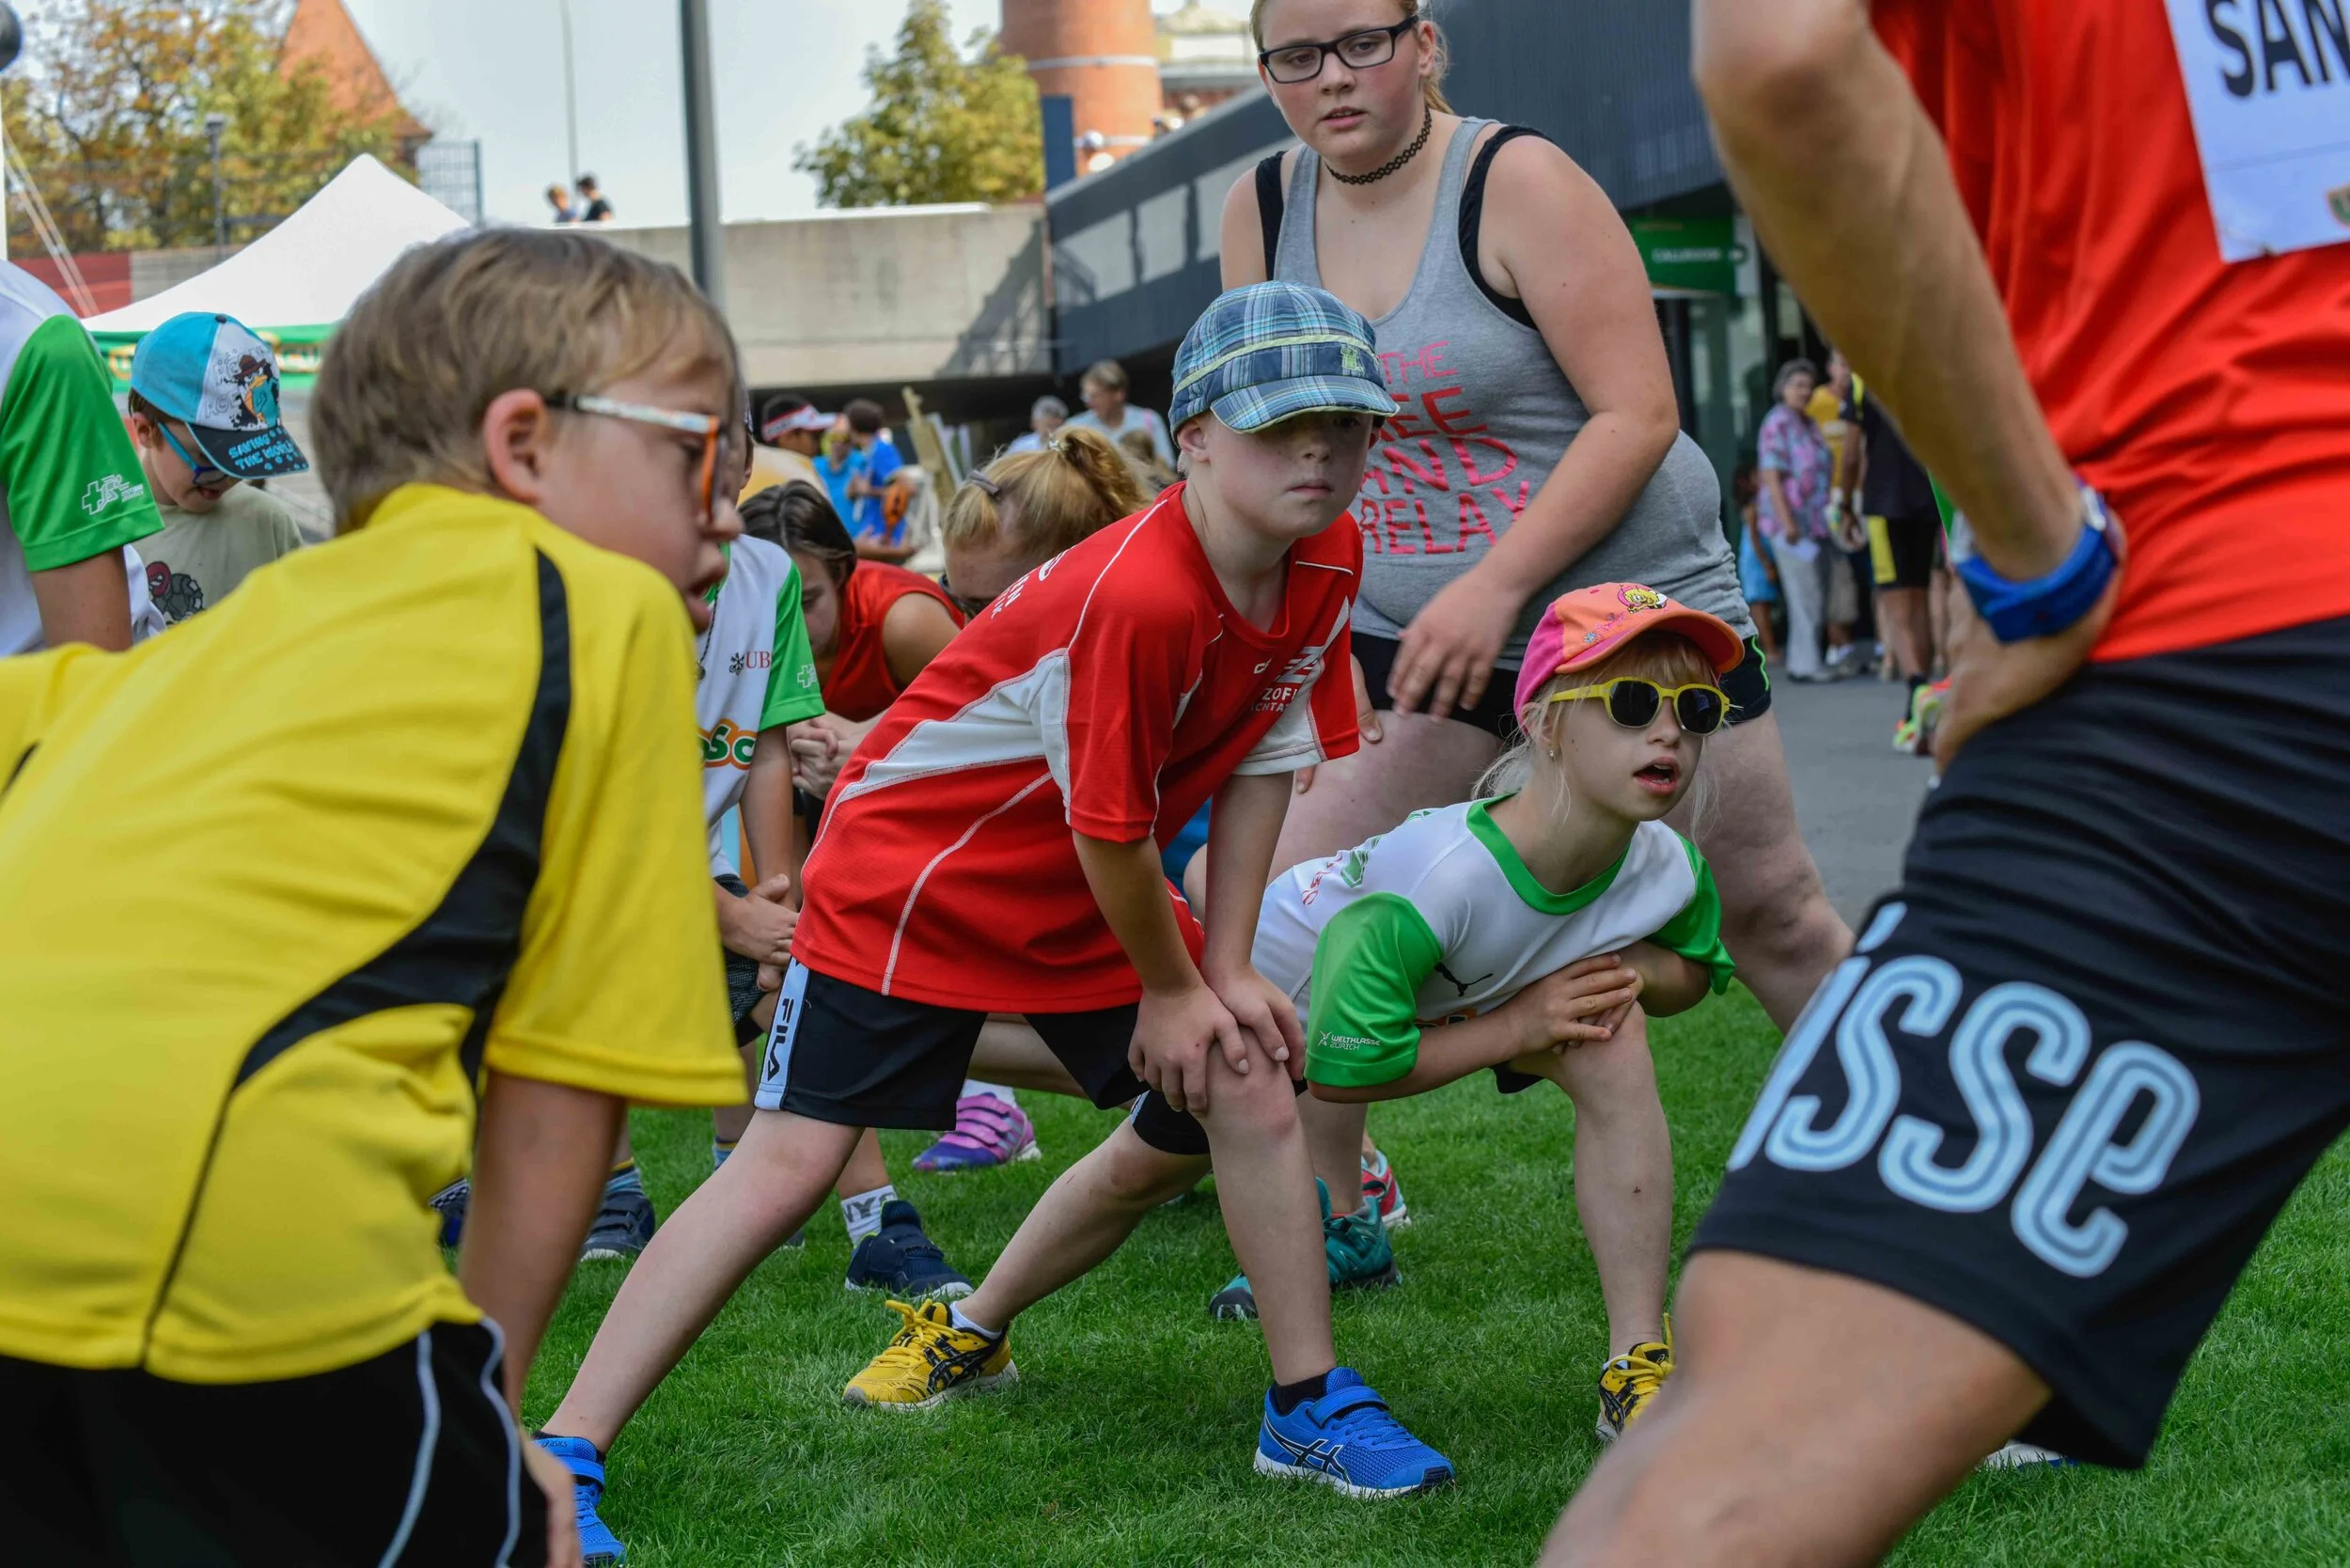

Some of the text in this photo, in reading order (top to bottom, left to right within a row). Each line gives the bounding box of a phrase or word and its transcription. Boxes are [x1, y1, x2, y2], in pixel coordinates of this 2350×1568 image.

[1378, 340, 1458, 384] THE
[228, 433, 271, 459] SAVING
[235, 451, 263, 470] THE
[1360, 437, 1518, 492] AND
[1359, 480, 1529, 554] RELAY
[767, 997, 794, 1082] FILA
[1331, 1035, 1381, 1046] WELTKLASSE
